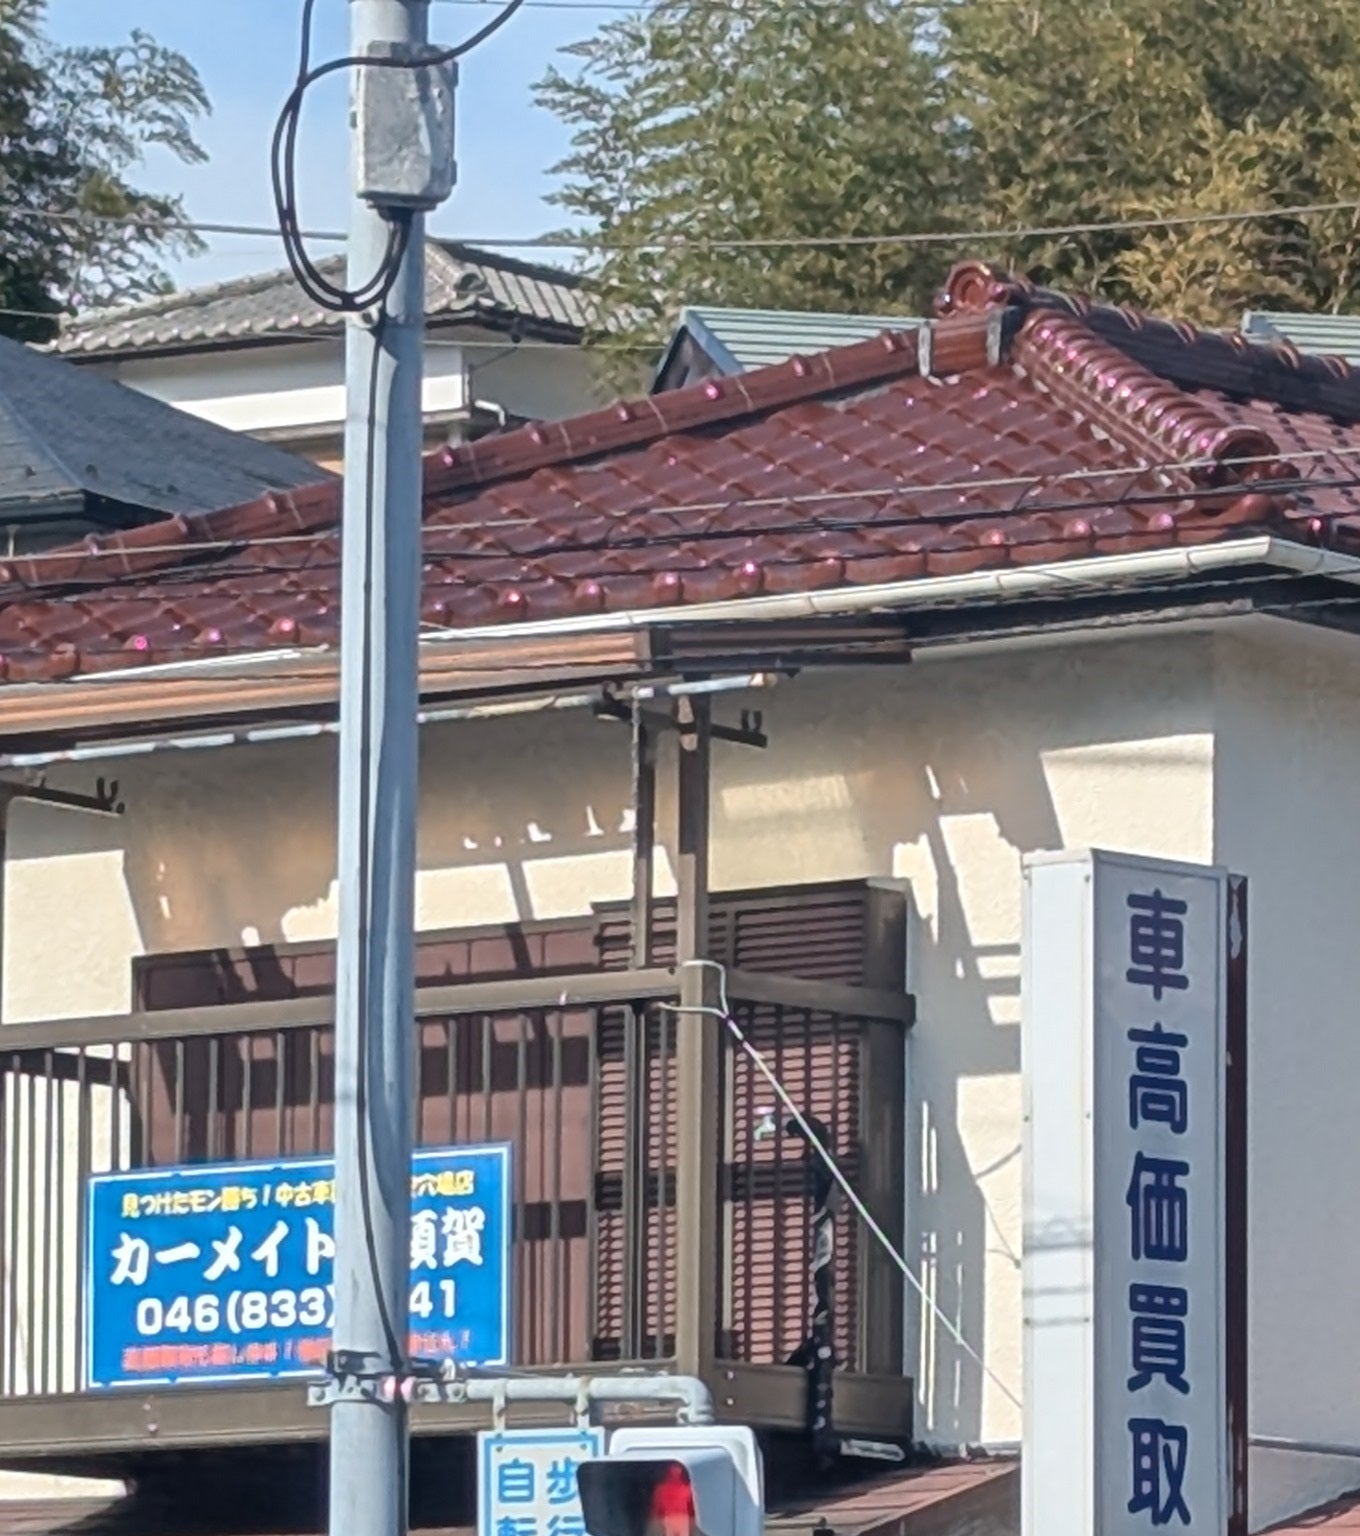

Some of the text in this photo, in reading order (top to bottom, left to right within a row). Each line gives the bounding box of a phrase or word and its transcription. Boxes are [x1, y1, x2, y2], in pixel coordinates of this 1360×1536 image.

[121, 1177, 336, 1219] 見つけたモン勝ち！中古車
[1126, 888, 1191, 1526] 車高価買取
[109, 1205, 486, 1287] カーメイト須賀
